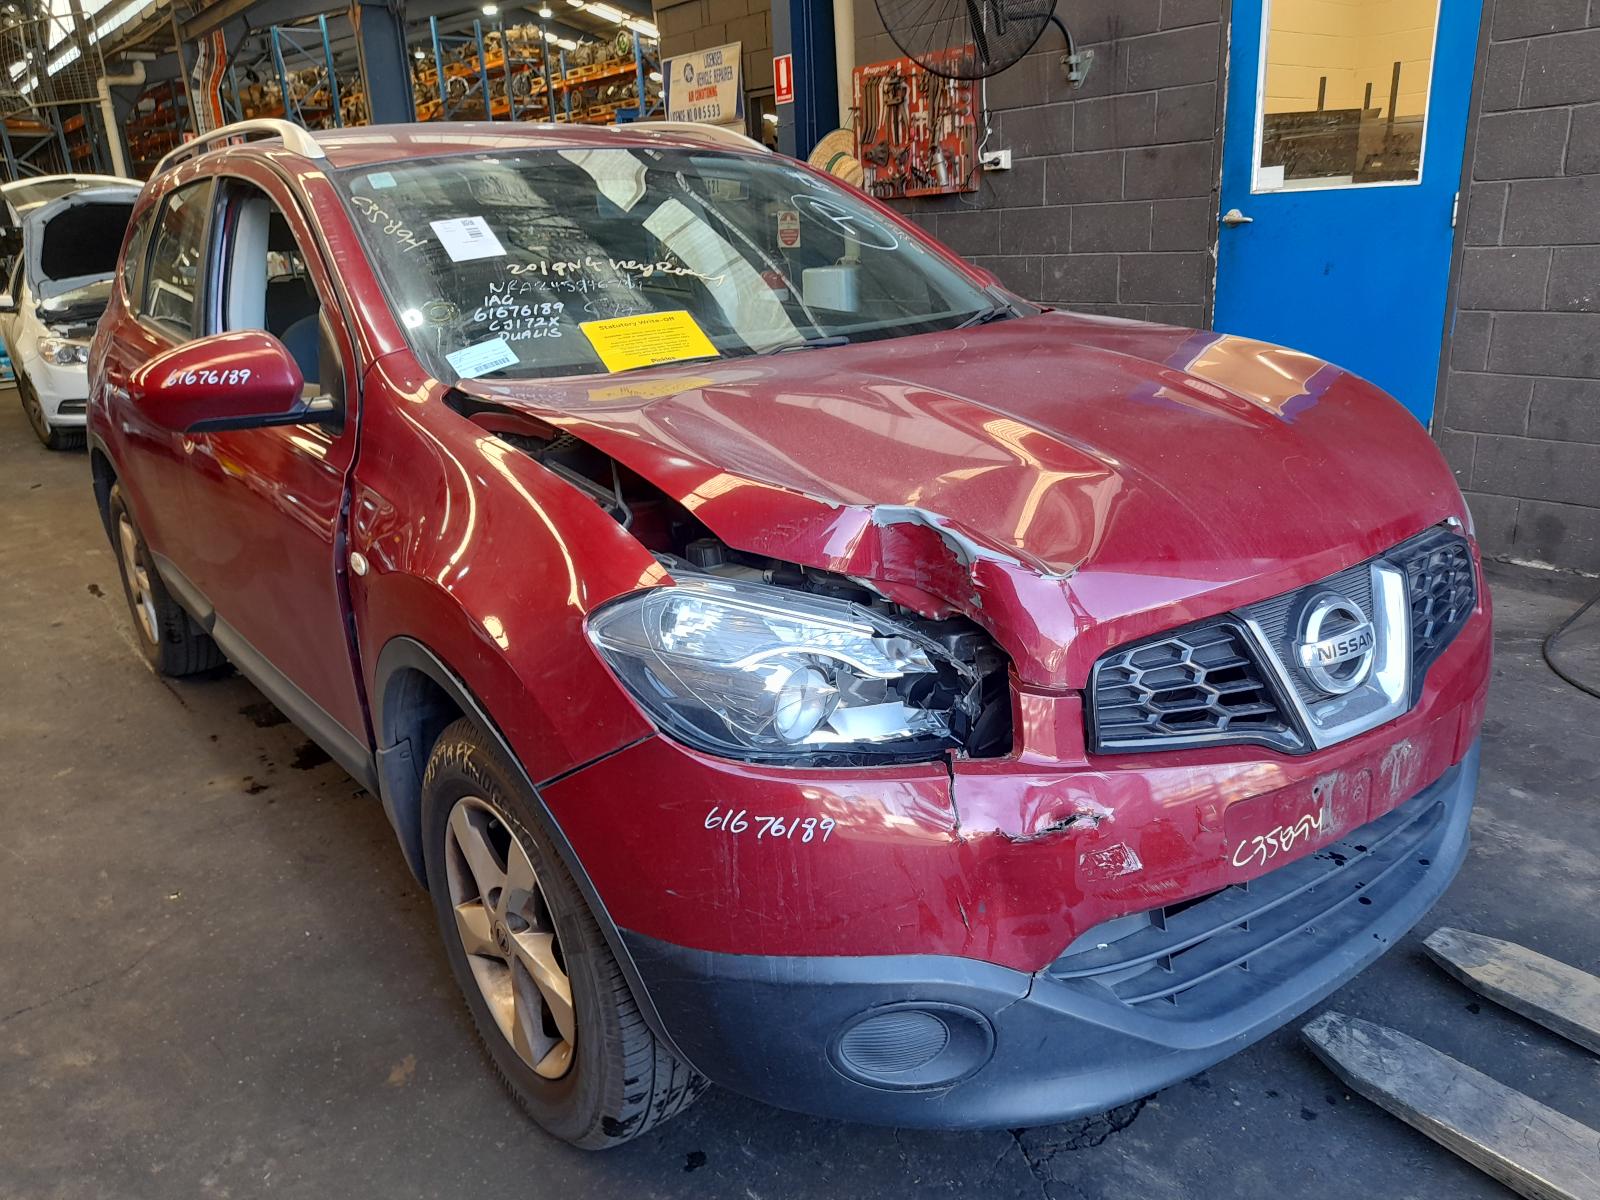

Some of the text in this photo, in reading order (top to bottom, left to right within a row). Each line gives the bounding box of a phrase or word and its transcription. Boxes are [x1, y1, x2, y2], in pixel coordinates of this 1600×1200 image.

[696, 66, 733, 87] VEHICLE REPAIRER
[474, 302, 564, 322] 61676189
[498, 327, 562, 341] DUALIS
[598, 321, 637, 331] Statutory
[167, 369, 252, 387] 61676189
[1317, 631, 1374, 661] NISSAN
[704, 806, 836, 843] 61676189
